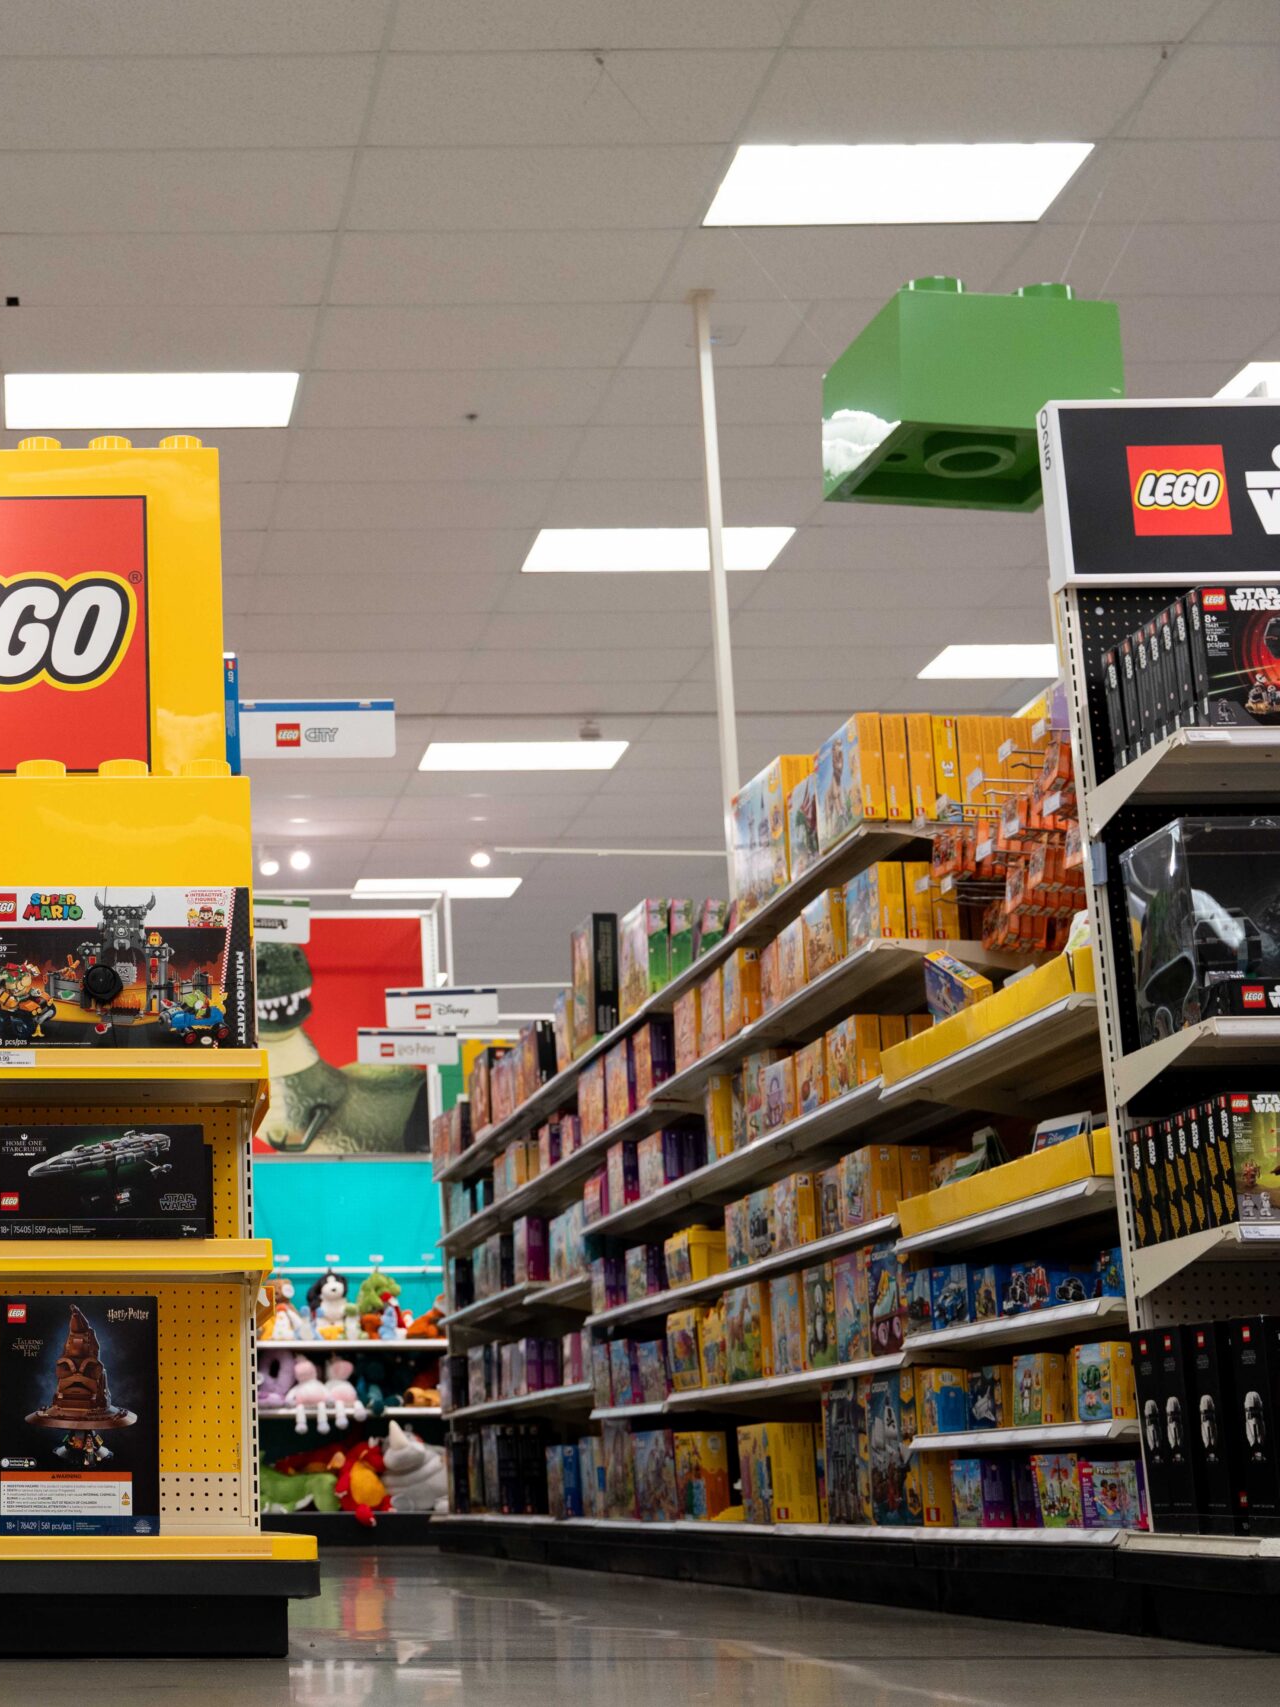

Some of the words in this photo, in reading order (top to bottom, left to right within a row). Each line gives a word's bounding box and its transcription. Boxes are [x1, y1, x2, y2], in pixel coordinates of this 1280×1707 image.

[1137, 472, 1220, 507] LEGO
[1204, 594, 1225, 604] LEGO
[1204, 614, 1218, 623] 8+
[277, 729, 300, 740] LEGO
[304, 727, 339, 742] CITY
[30, 893, 77, 906] SUPER
[22, 904, 84, 922] MARIO
[1245, 992, 1264, 1001] LEGO
[4, 1038, 27, 1047] pcs/pzs
[1232, 1099, 1249, 1108] LEGO
[1257, 1094, 1280, 1104] STA
[1, 1196, 18, 1206] LEGO
[163, 1193, 195, 1202] STAR
[159, 1200, 198, 1211] WARS
[0, 1226, 10, 1234] 18+
[13, 1226, 32, 1234] 75405
[34, 1226, 46, 1234] 559
[47, 1226, 69, 1235] pcs/pzs
[8, 1309, 26, 1318] LEGO
[106, 1308, 128, 1322] Harry
[128, 1307, 150, 1320] Potter
[41, 1522, 51, 1530] 561
[51, 1522, 72, 1531] pcs/pzs
